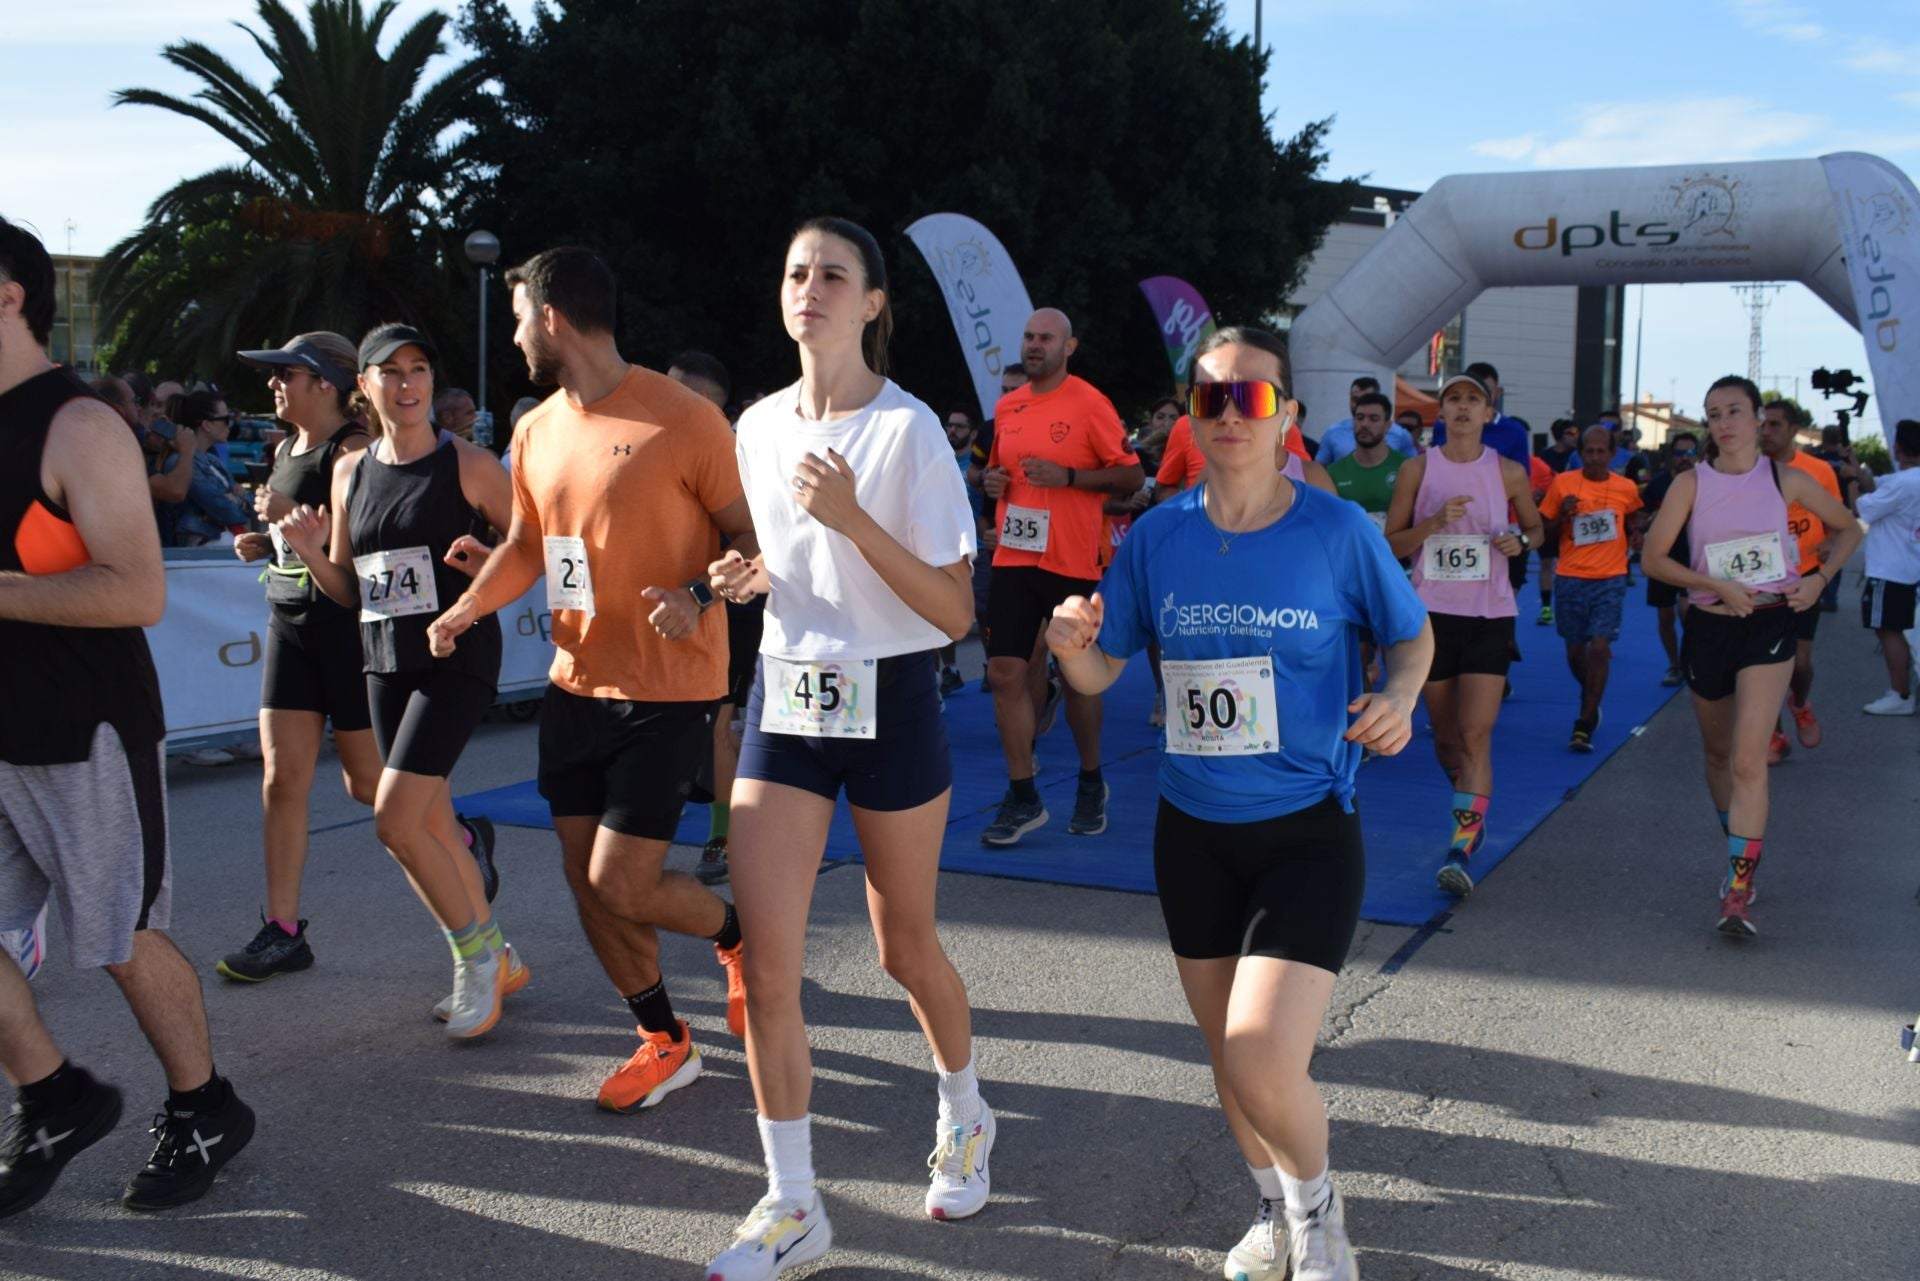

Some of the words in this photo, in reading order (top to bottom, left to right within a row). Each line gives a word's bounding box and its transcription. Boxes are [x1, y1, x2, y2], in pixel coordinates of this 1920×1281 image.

[1514, 210, 1680, 257] dpts
[1003, 516, 1038, 539] 335
[1580, 518, 1610, 536] 395
[1435, 548, 1477, 568] 165
[1730, 550, 1762, 573] 43
[369, 566, 419, 601] 274
[1178, 603, 1319, 630] SERGIOMOYA
[1178, 624, 1221, 637] Nutrición
[1222, 626, 1227, 637] y
[1230, 624, 1272, 638] Dietética
[794, 671, 840, 711] 45
[1188, 687, 1236, 729] 50
